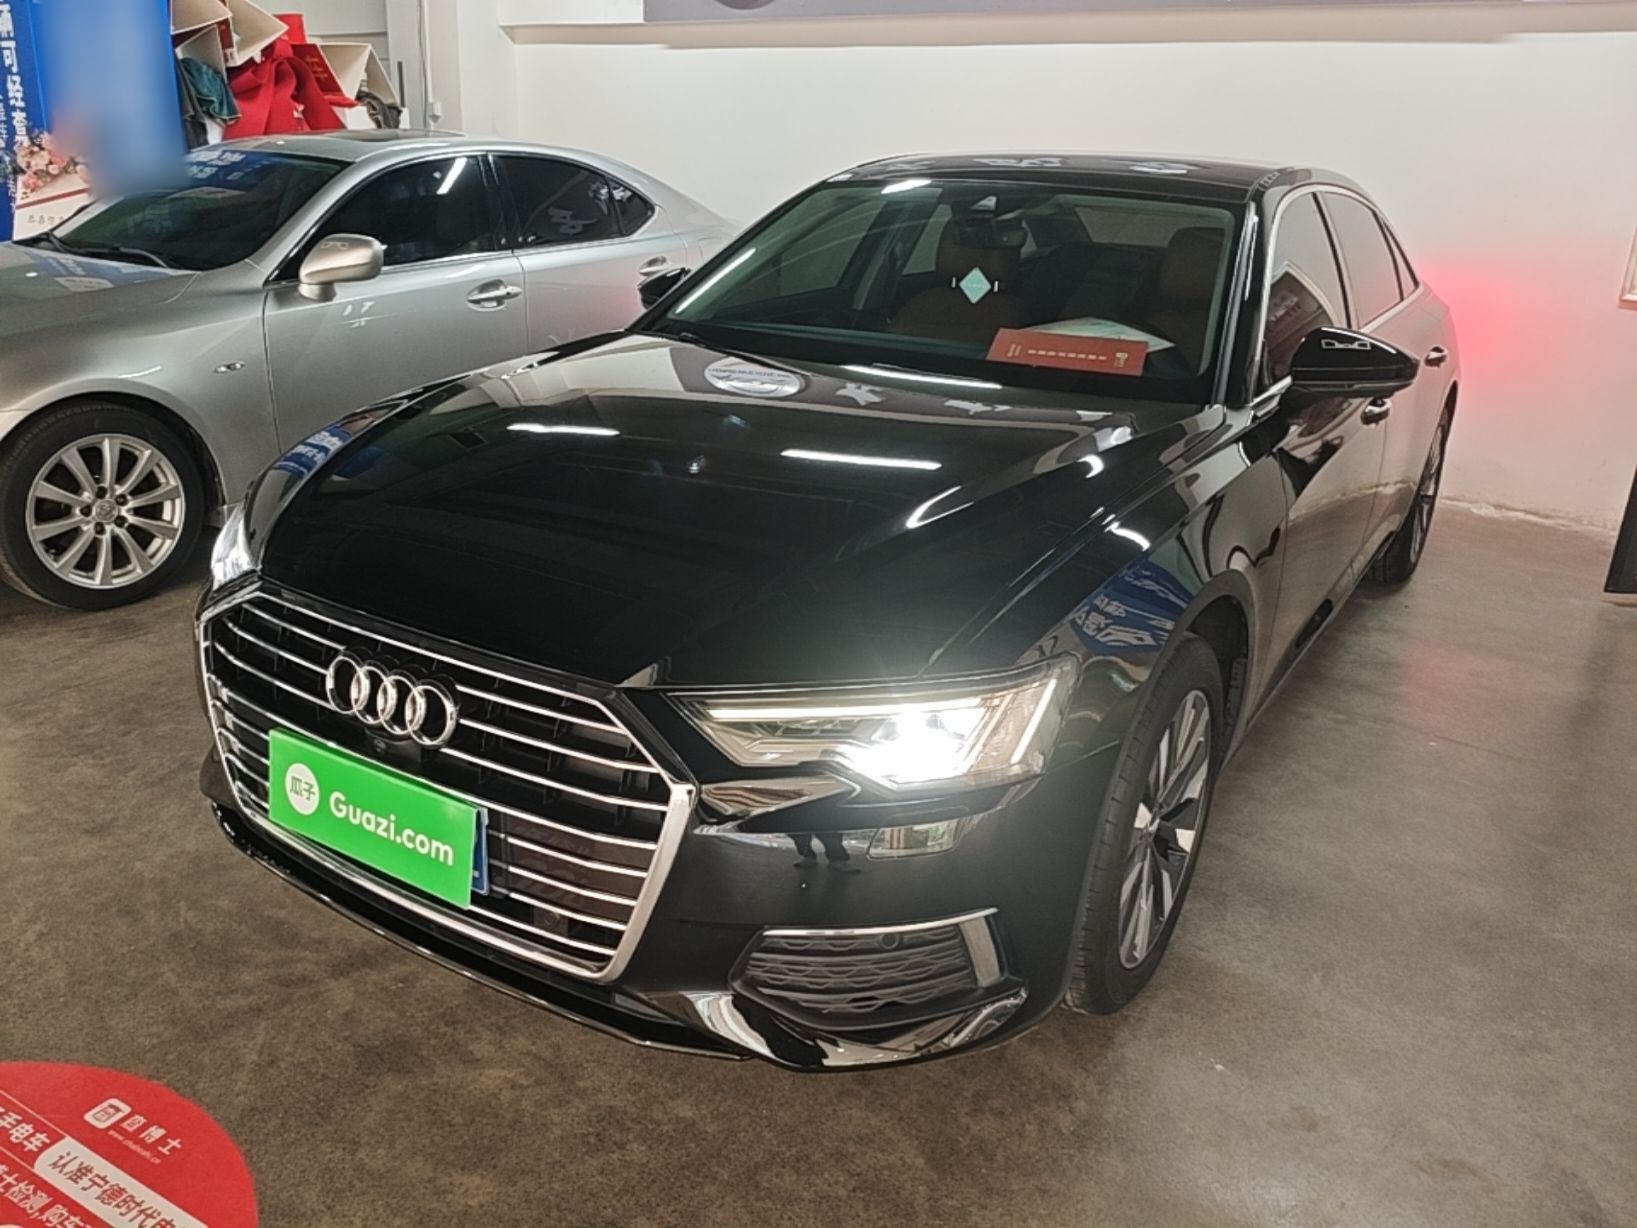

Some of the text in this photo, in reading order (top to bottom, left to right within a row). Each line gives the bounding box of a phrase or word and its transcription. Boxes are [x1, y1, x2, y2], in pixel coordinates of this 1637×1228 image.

[290, 775, 316, 801] 瓜子
[329, 791, 454, 867] Guazi.com
[120, 1114, 182, 1155] 查博士
